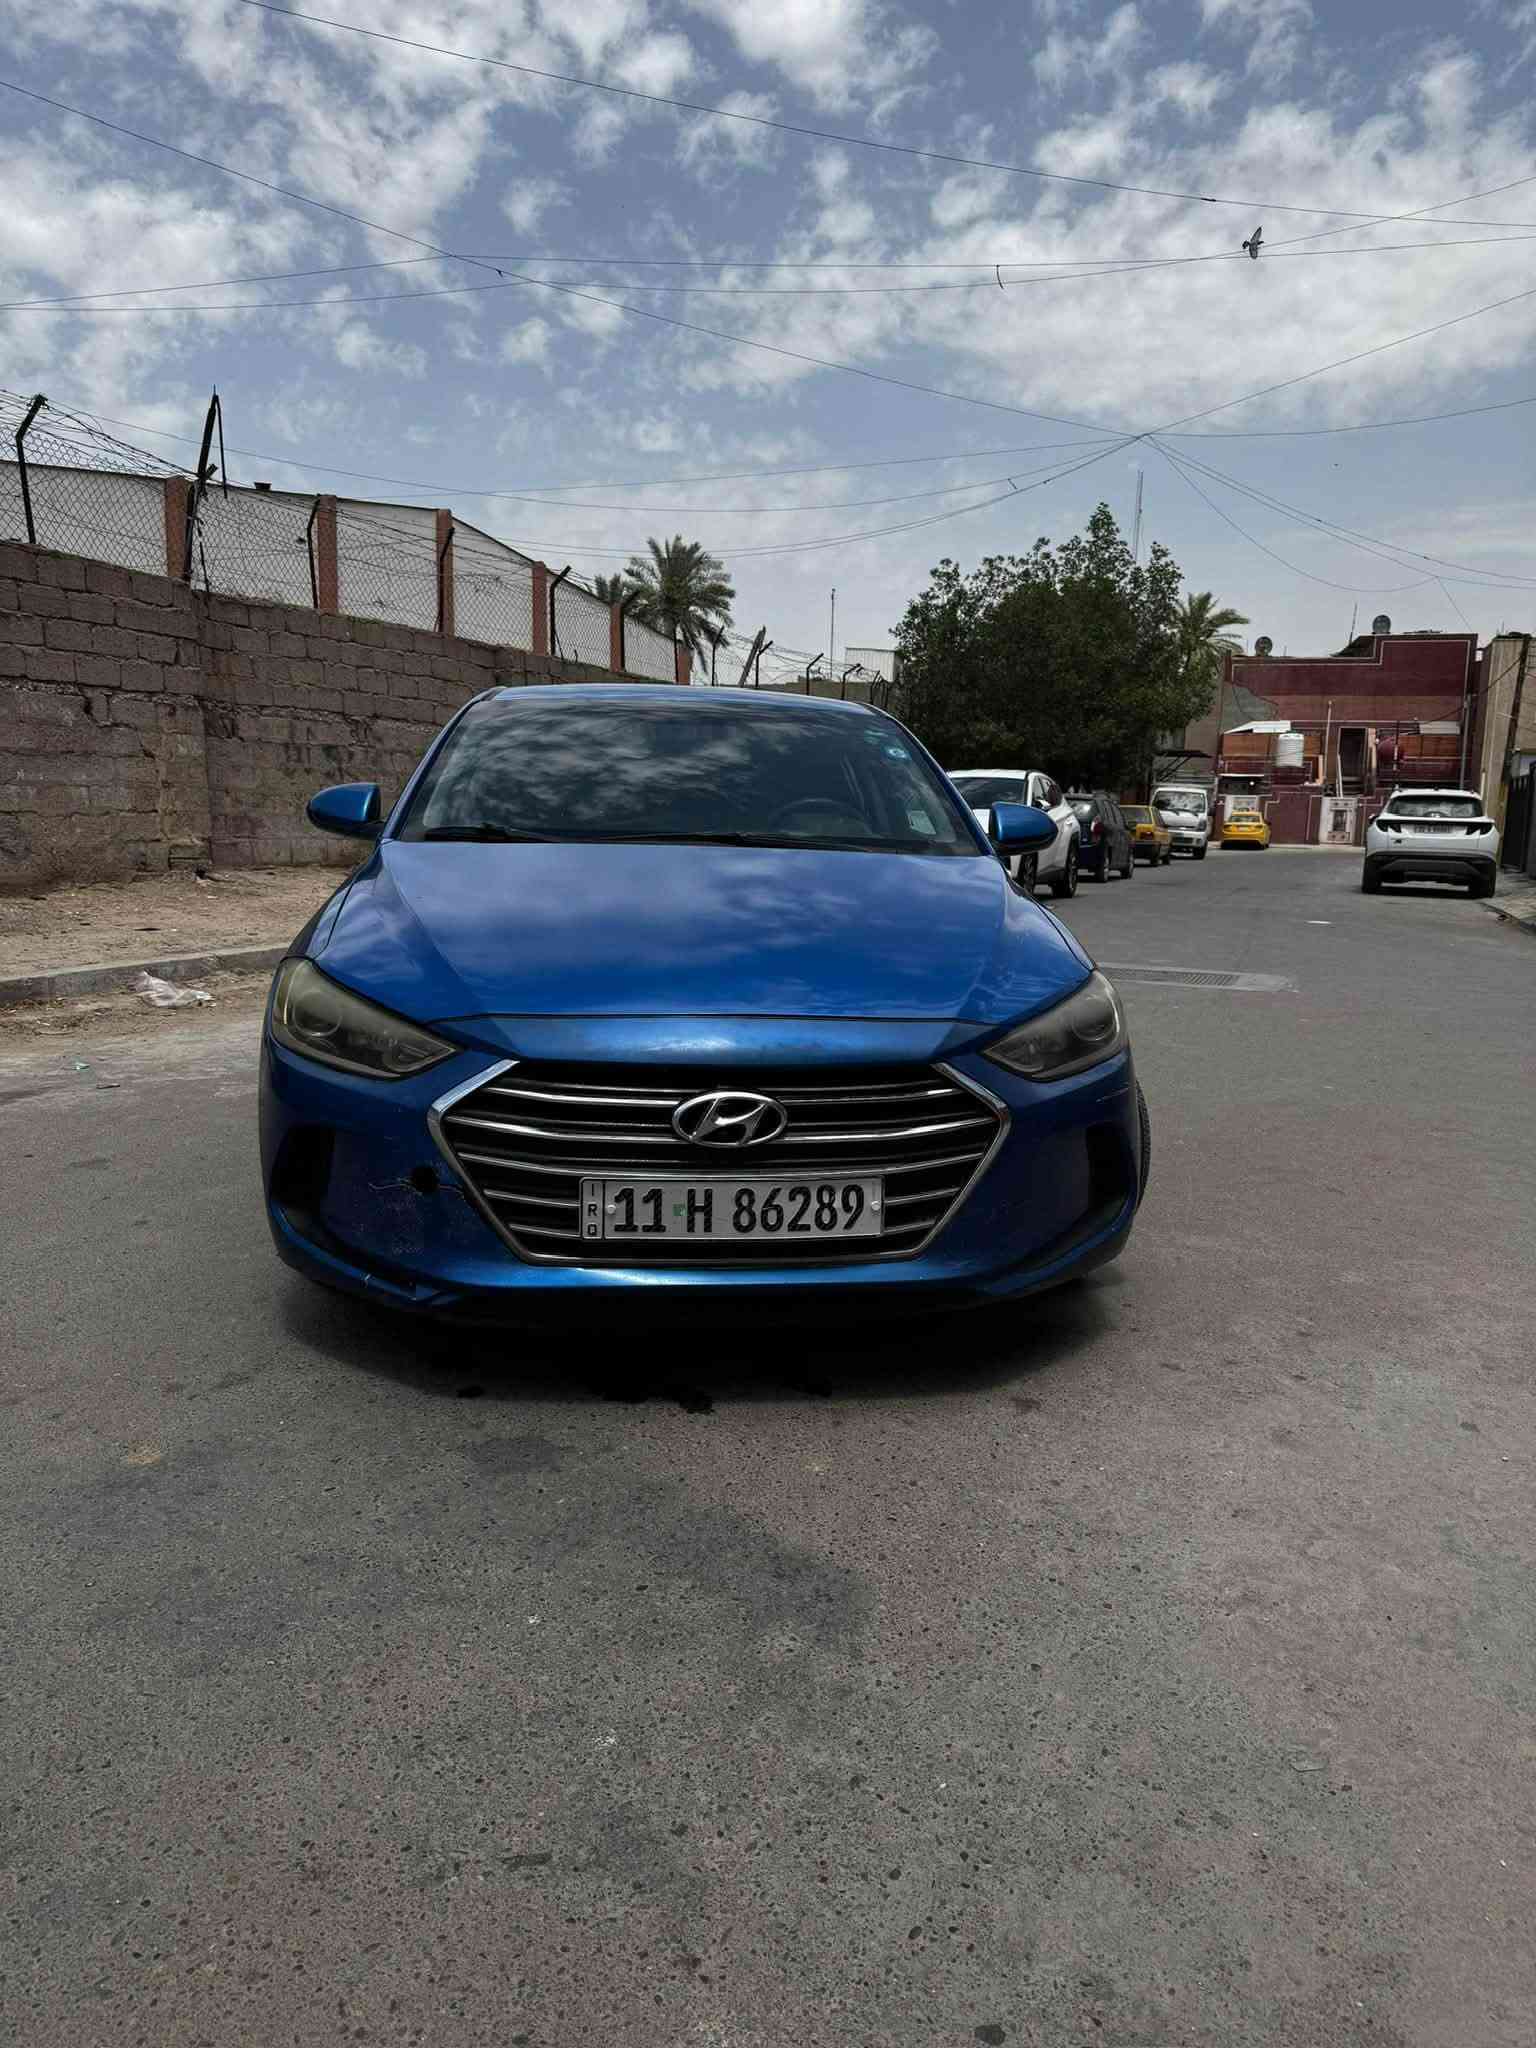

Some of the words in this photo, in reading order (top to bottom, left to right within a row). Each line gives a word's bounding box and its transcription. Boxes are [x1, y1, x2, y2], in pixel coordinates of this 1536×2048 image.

[587, 1183, 598, 1236] IRQ
[614, 1187, 667, 1232] 11
[686, 1188, 713, 1233] H
[732, 1184, 865, 1233] 86289
